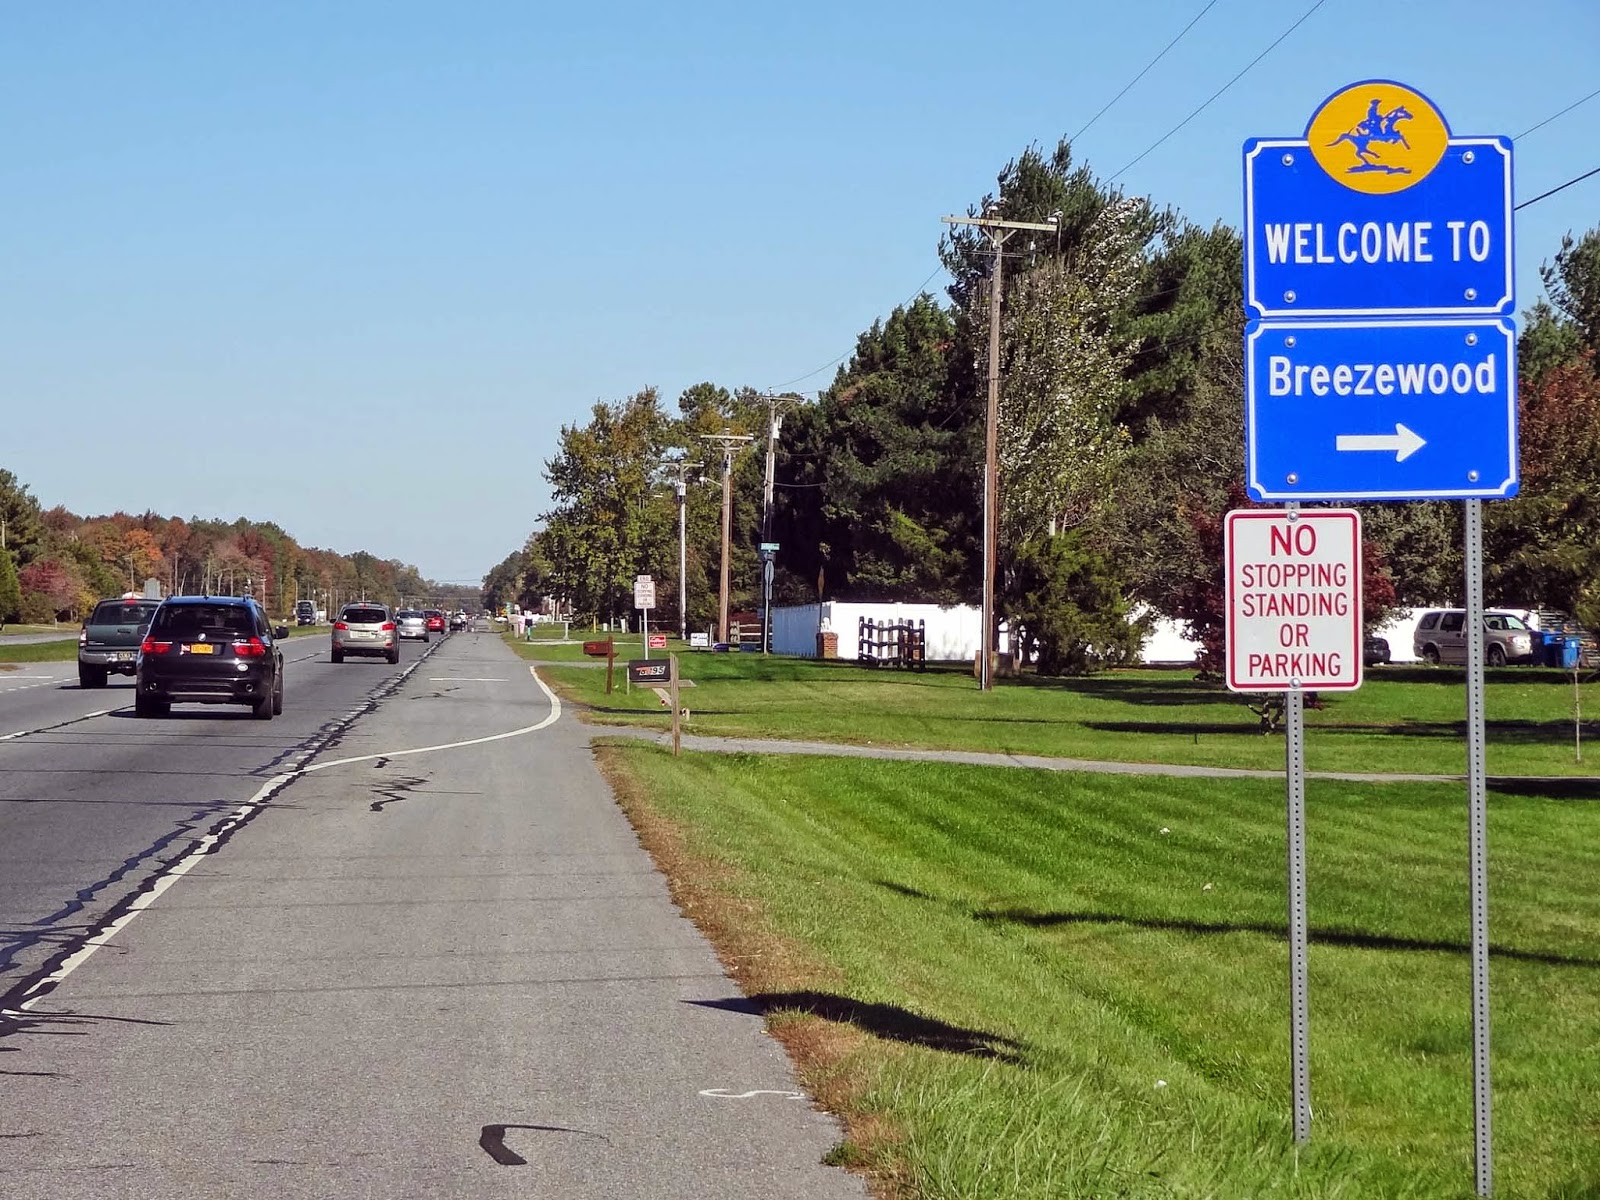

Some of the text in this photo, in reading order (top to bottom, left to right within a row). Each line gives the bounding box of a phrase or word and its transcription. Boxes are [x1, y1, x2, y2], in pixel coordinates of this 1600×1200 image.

[1264, 220, 1490, 264] WELCOME TO
[1269, 353, 1496, 397] Breezewood
[1270, 524, 1317, 556] NO
[1241, 563, 1347, 588] STOPPING
[1241, 592, 1348, 617] STANDING
[1279, 623, 1309, 647] OR
[1249, 653, 1341, 677] PARKING
